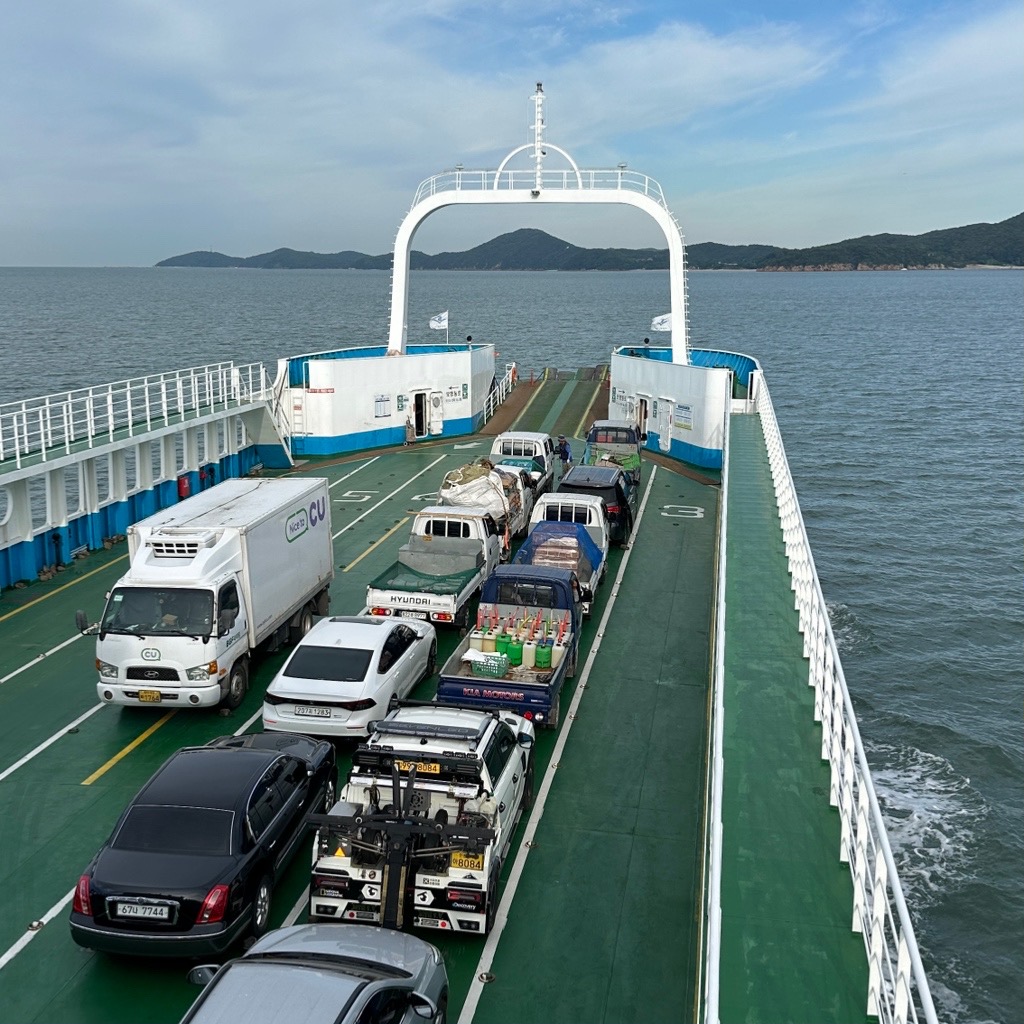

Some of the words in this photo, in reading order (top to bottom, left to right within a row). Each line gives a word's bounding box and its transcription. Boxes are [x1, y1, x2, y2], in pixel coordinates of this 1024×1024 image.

[310, 496, 326, 527] CU
[390, 595, 431, 605] HYUNDAI
[463, 687, 481, 697] KIA
[483, 689, 525, 701] MOTORS
